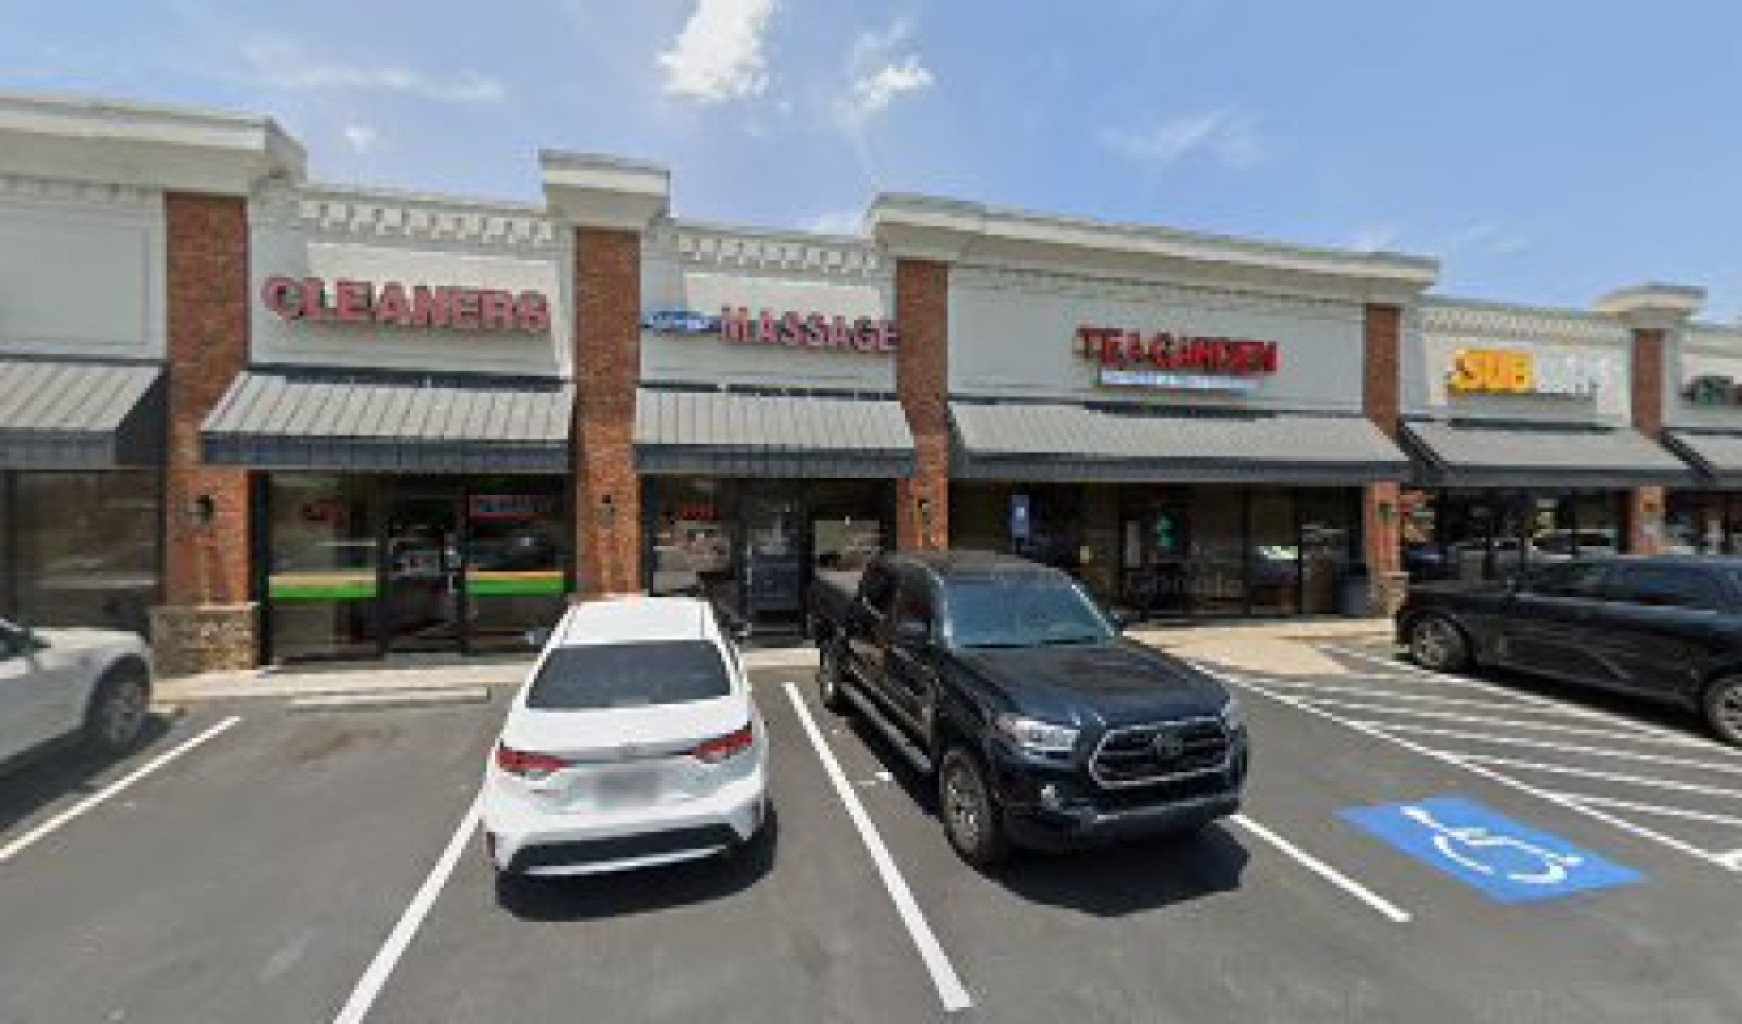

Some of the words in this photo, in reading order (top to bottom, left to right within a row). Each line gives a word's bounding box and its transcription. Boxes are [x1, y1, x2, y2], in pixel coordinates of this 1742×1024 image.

[262, 276, 549, 331] CLEANERS
[721, 306, 898, 352] MASSAGE
[1075, 327, 1146, 367] TEA
[1150, 332, 1280, 375] GARDEN
